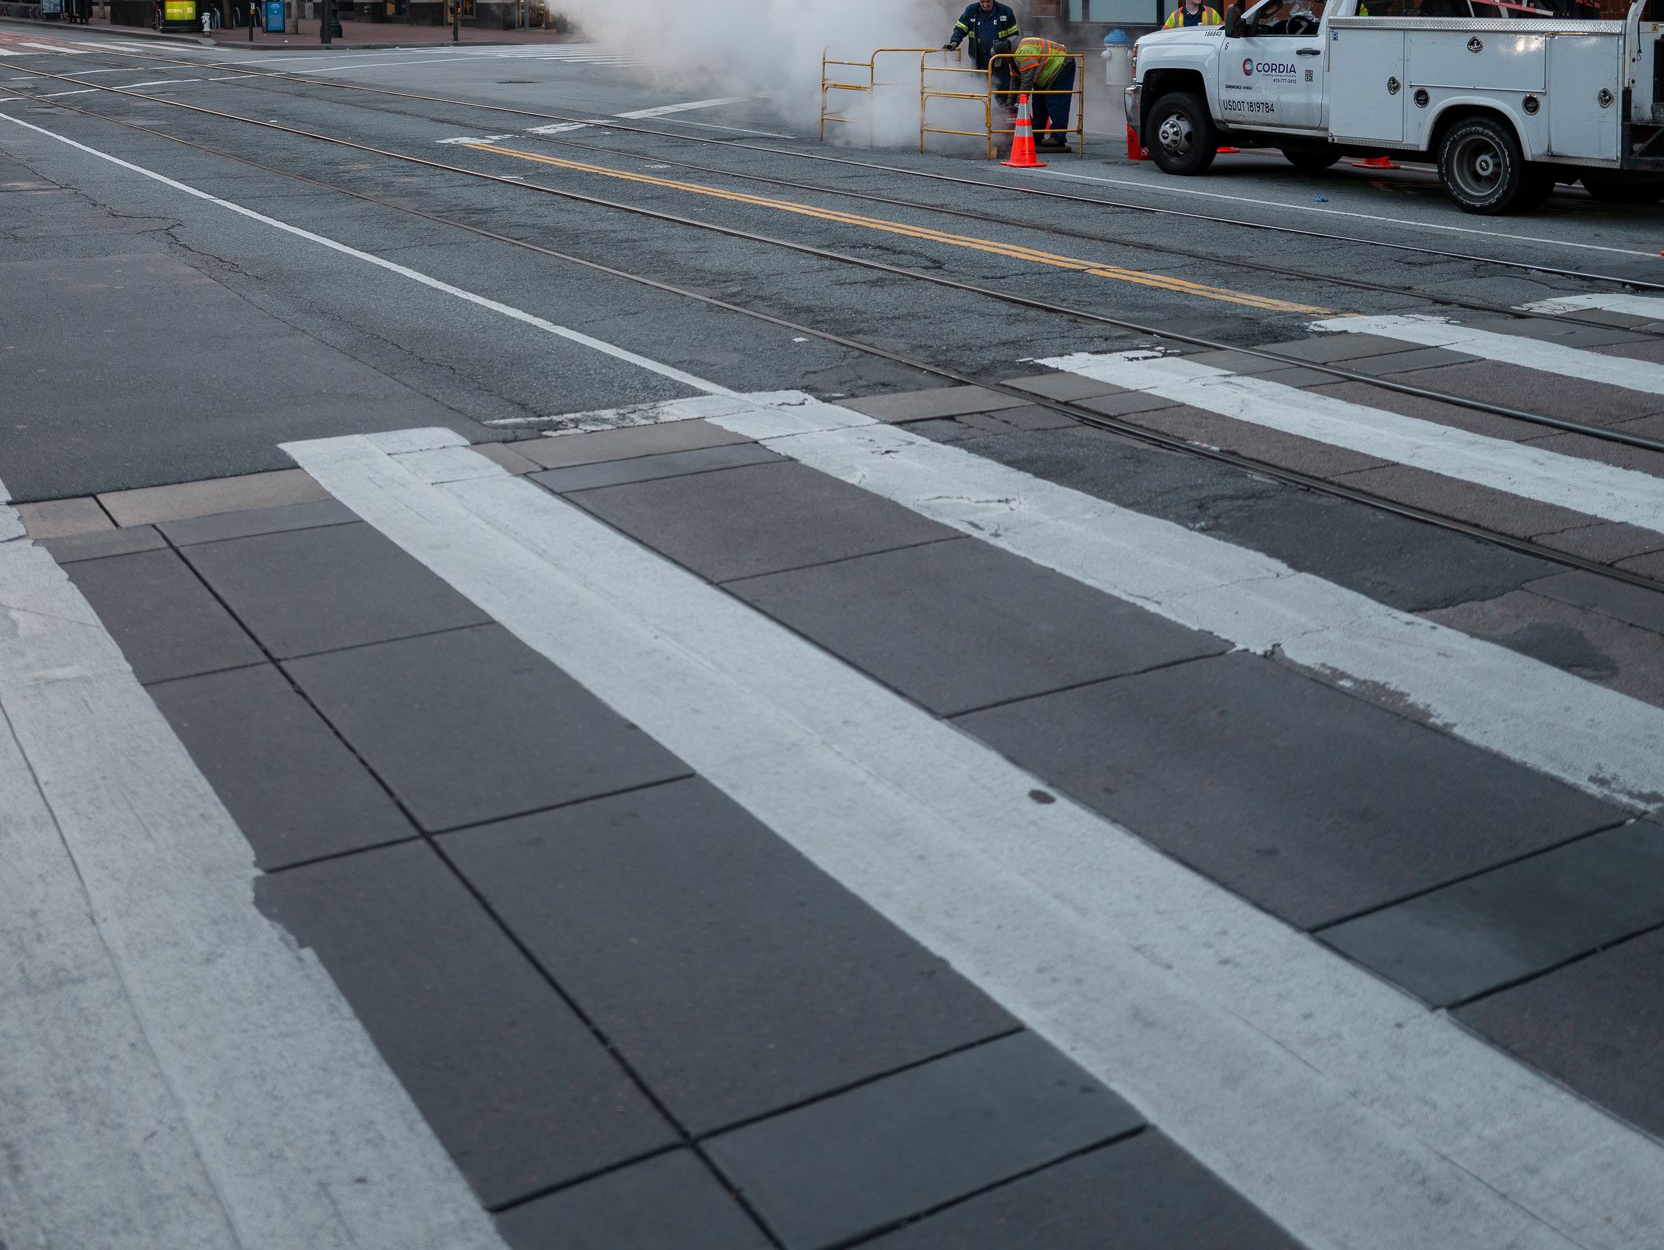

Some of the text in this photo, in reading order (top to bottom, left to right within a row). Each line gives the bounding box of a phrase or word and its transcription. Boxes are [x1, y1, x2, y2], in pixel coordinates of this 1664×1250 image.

[1225, 42, 1230, 50] 6
[1256, 62, 1297, 74] CORDIA
[1223, 100, 1275, 113] USDOT 1819784
